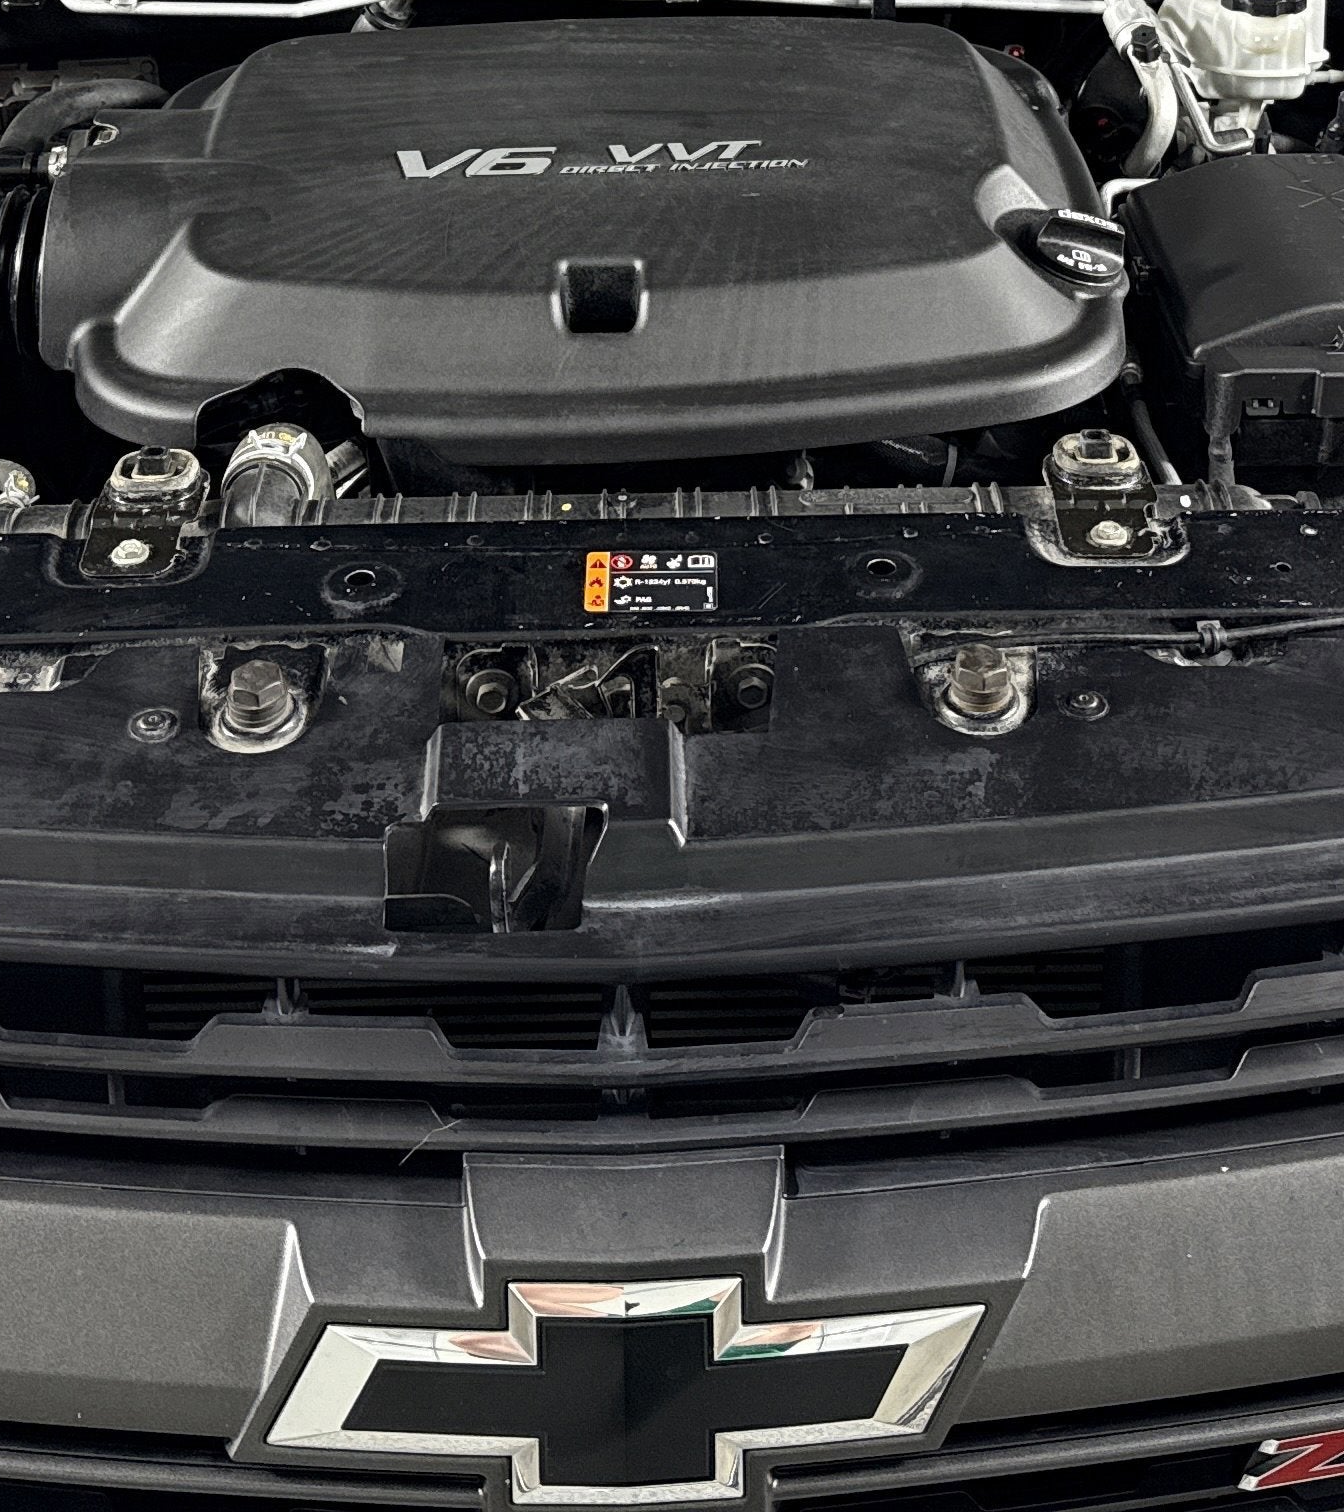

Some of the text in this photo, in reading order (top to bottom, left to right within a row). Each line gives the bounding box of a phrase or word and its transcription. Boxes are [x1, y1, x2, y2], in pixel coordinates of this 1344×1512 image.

[396, 147, 557, 178] V6
[609, 141, 762, 163] VVT
[560, 159, 808, 175] DIRECT INJECTION
